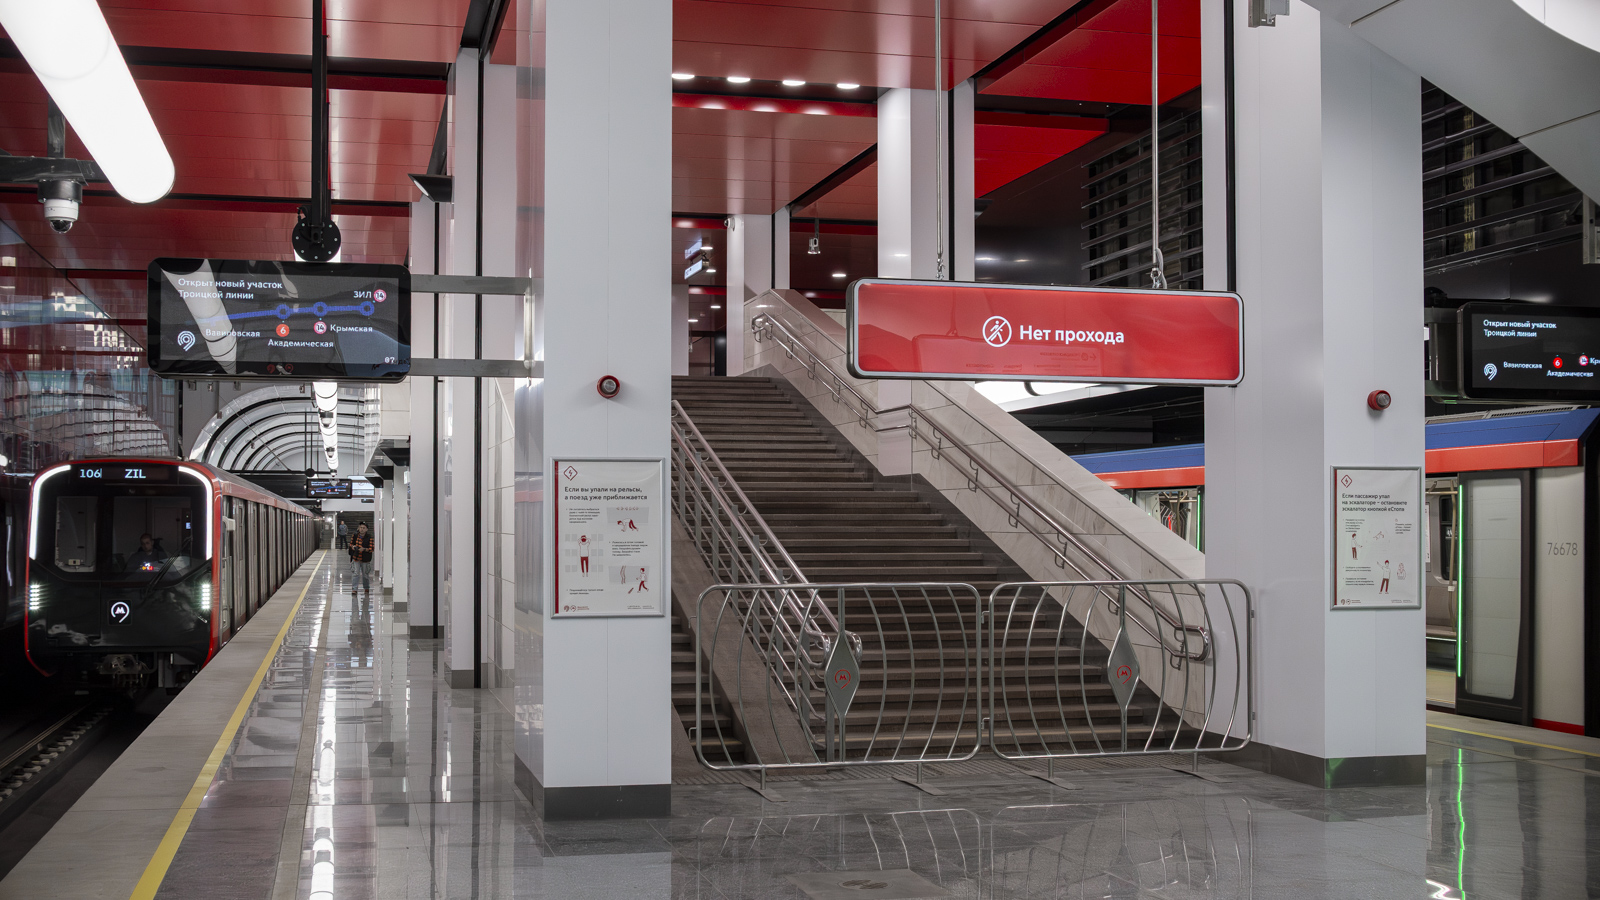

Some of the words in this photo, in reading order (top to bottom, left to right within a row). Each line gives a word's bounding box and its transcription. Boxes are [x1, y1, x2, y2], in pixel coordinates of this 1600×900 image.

[178, 278, 213, 288] Открыт
[215, 280, 245, 288] новый
[247, 281, 282, 290] участок
[178, 289, 223, 299] Троицкой
[353, 290, 372, 299] ЗИЛ
[330, 324, 373, 333] Крымская
[1483, 319, 1508, 328] Открыт
[1531, 322, 1557, 330] участок
[1019, 324, 1051, 341] Нет
[1055, 329, 1125, 345] прохода
[1484, 329, 1516, 338] Троицкой
[267, 338, 334, 348] Академическая
[1503, 361, 1543, 369] Вавиловская
[79, 468, 101, 479] 106
[124, 468, 146, 479] ZIL
[1547, 542, 1578, 556] 76678
